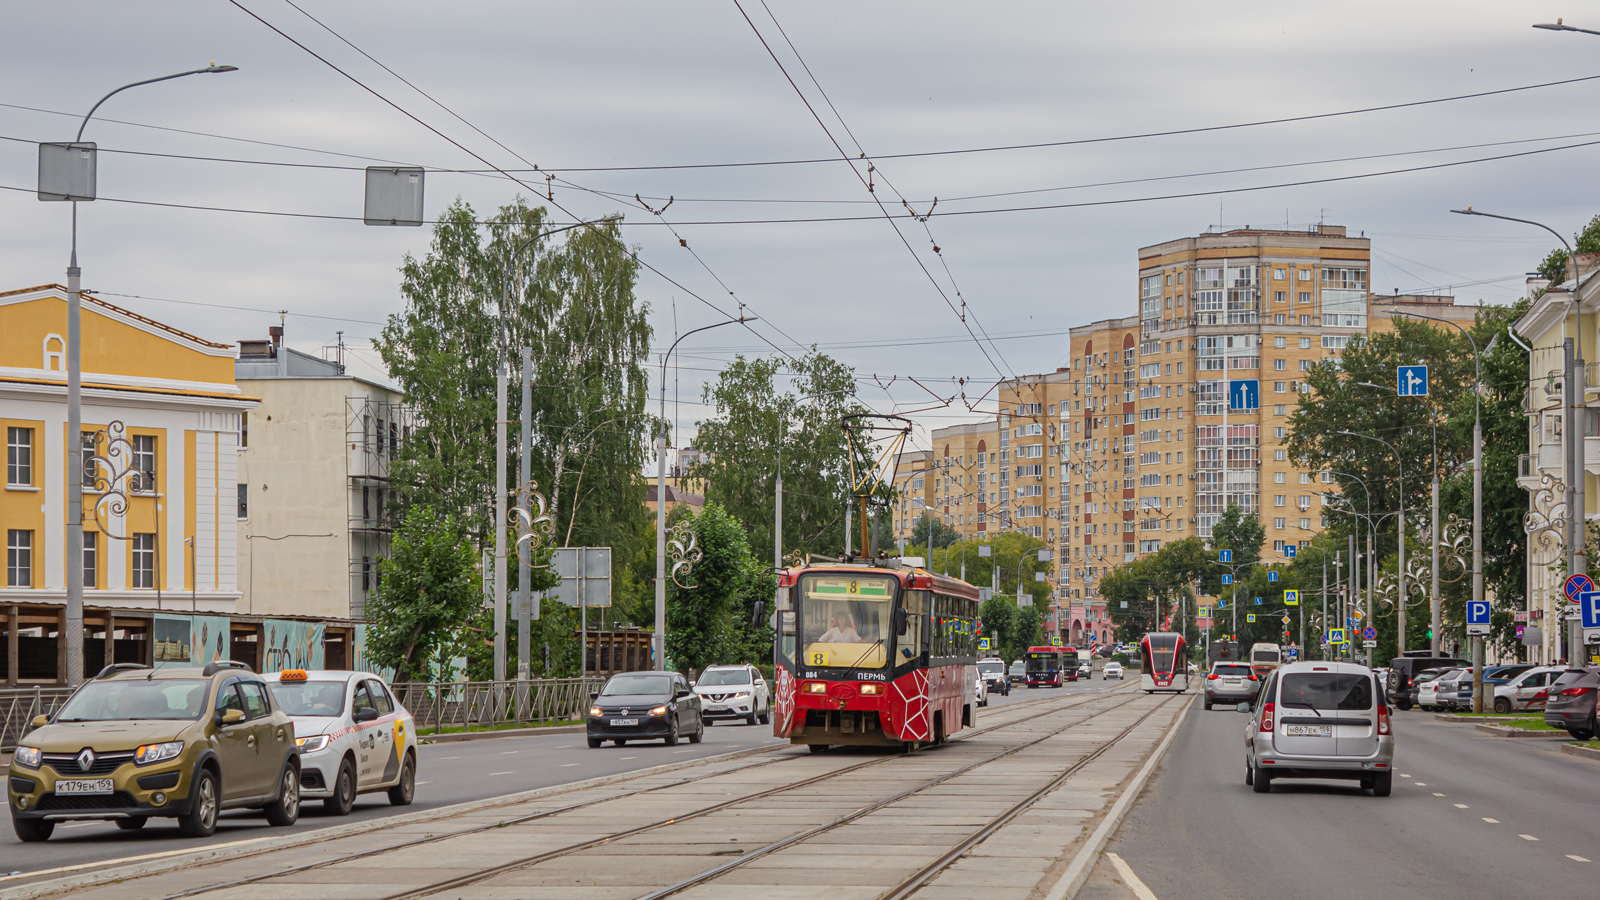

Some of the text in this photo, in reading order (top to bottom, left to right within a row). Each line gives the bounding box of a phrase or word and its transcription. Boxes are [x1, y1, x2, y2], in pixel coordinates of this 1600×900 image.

[849, 580, 857, 593] 8
[1473, 603, 1486, 622] P
[813, 653, 824, 665] 8
[805, 671, 818, 679] 084
[857, 672, 886, 680] ПЕРМЬ
[58, 780, 111, 791] К179ЕН 159
